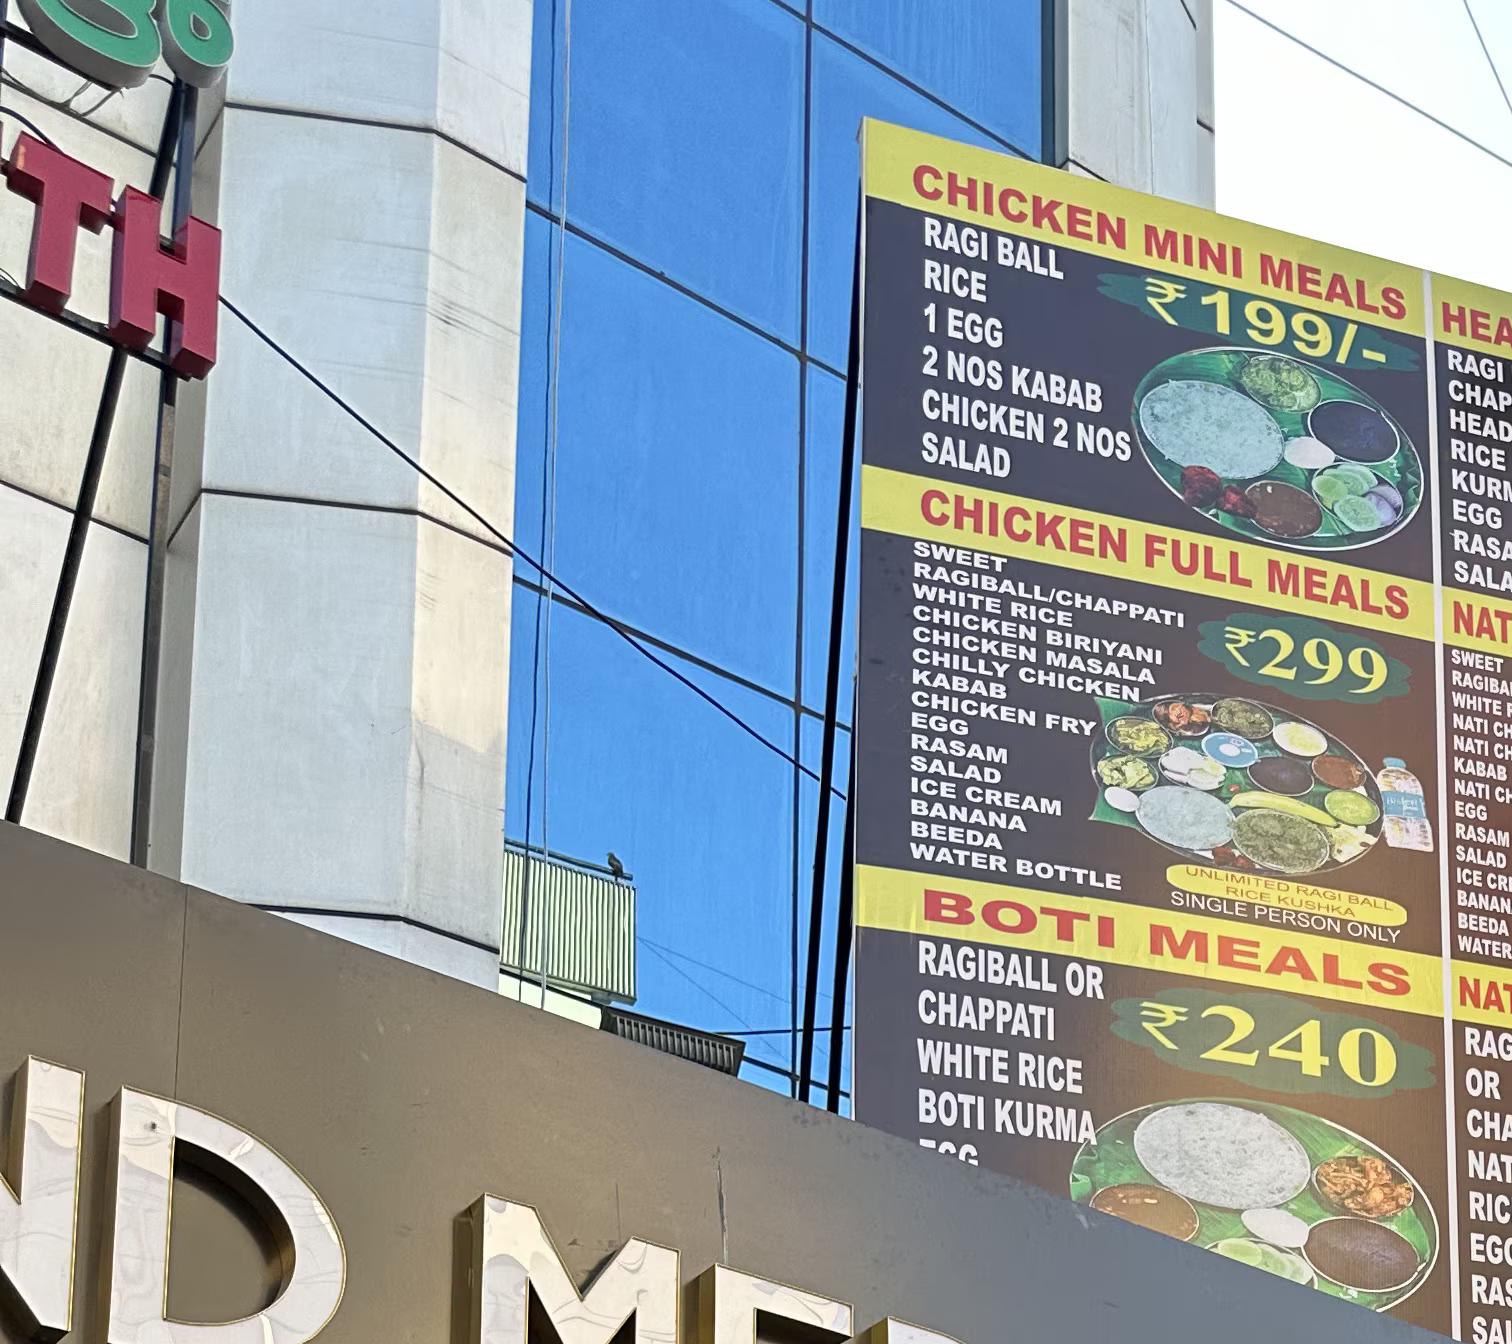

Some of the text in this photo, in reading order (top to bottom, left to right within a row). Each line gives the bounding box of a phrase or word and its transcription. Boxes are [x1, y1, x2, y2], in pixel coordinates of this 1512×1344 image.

[0, 120, 222, 380] TH
[913, 164, 1406, 320] CHICKEN MINI MEALS
[924, 216, 1064, 280] RAGI BALL
[924, 258, 987, 303] RICE
[924, 302, 1003, 348] 1 EGG
[922, 345, 1102, 413] 2 NOS KABAB
[1447, 349, 1503, 383] RAGI
[922, 388, 1131, 461] CHICKEN 2 NOS
[921, 431, 1010, 478] SALAD
[1450, 438, 1506, 471] RICE
[1452, 498, 1502, 529] EGG
[921, 489, 1408, 619] CHICKEN FULL MEALS
[912, 582, 1073, 628] WHITE RICE
[914, 561, 1184, 628] RAGIBALL/CHAPPATI
[912, 605, 1162, 665] CHICKEN BIRIYANI
[912, 647, 1139, 703] CHILLY CHICKEN
[911, 690, 1097, 736] CHICKEN FRY
[911, 776, 1061, 816] ICE CREAM
[1454, 778, 1490, 801] NATI
[910, 842, 1122, 890] WATER BOTTLE
[923, 889, 1411, 996] BOTI MEALS
[918, 940, 1104, 1000] RAGIBALL OR
[918, 989, 1054, 1041] CHAPPATI
[917, 1038, 1083, 1094] WHITE RICE
[1465, 1067, 1501, 1100] OR
[918, 1088, 1097, 1146] BOTI KURMA
